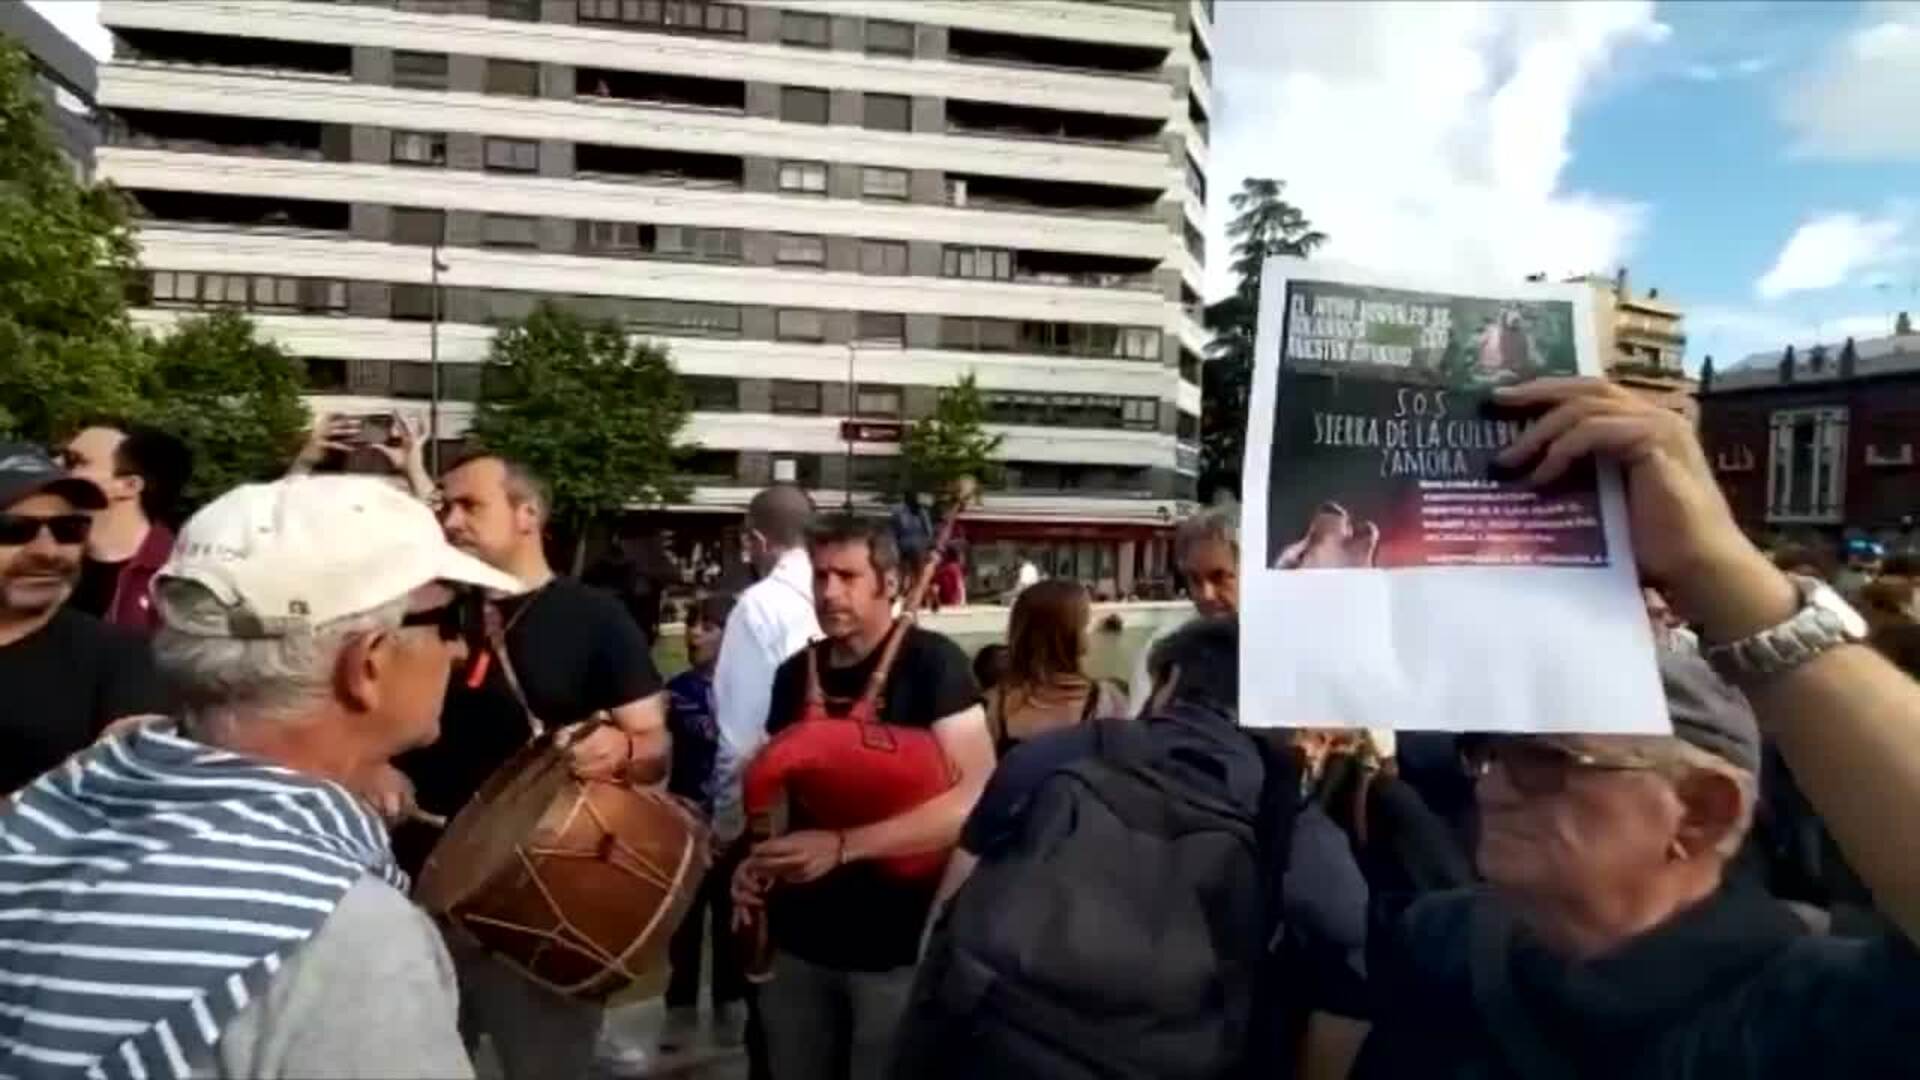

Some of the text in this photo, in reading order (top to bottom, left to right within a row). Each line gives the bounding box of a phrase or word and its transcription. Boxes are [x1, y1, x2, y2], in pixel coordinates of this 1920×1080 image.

[1314, 411, 1380, 447] SIERRA
[1386, 418, 1409, 449] DE
[1416, 420, 1440, 449] LA
[1381, 449, 1468, 478] ZAMORA
